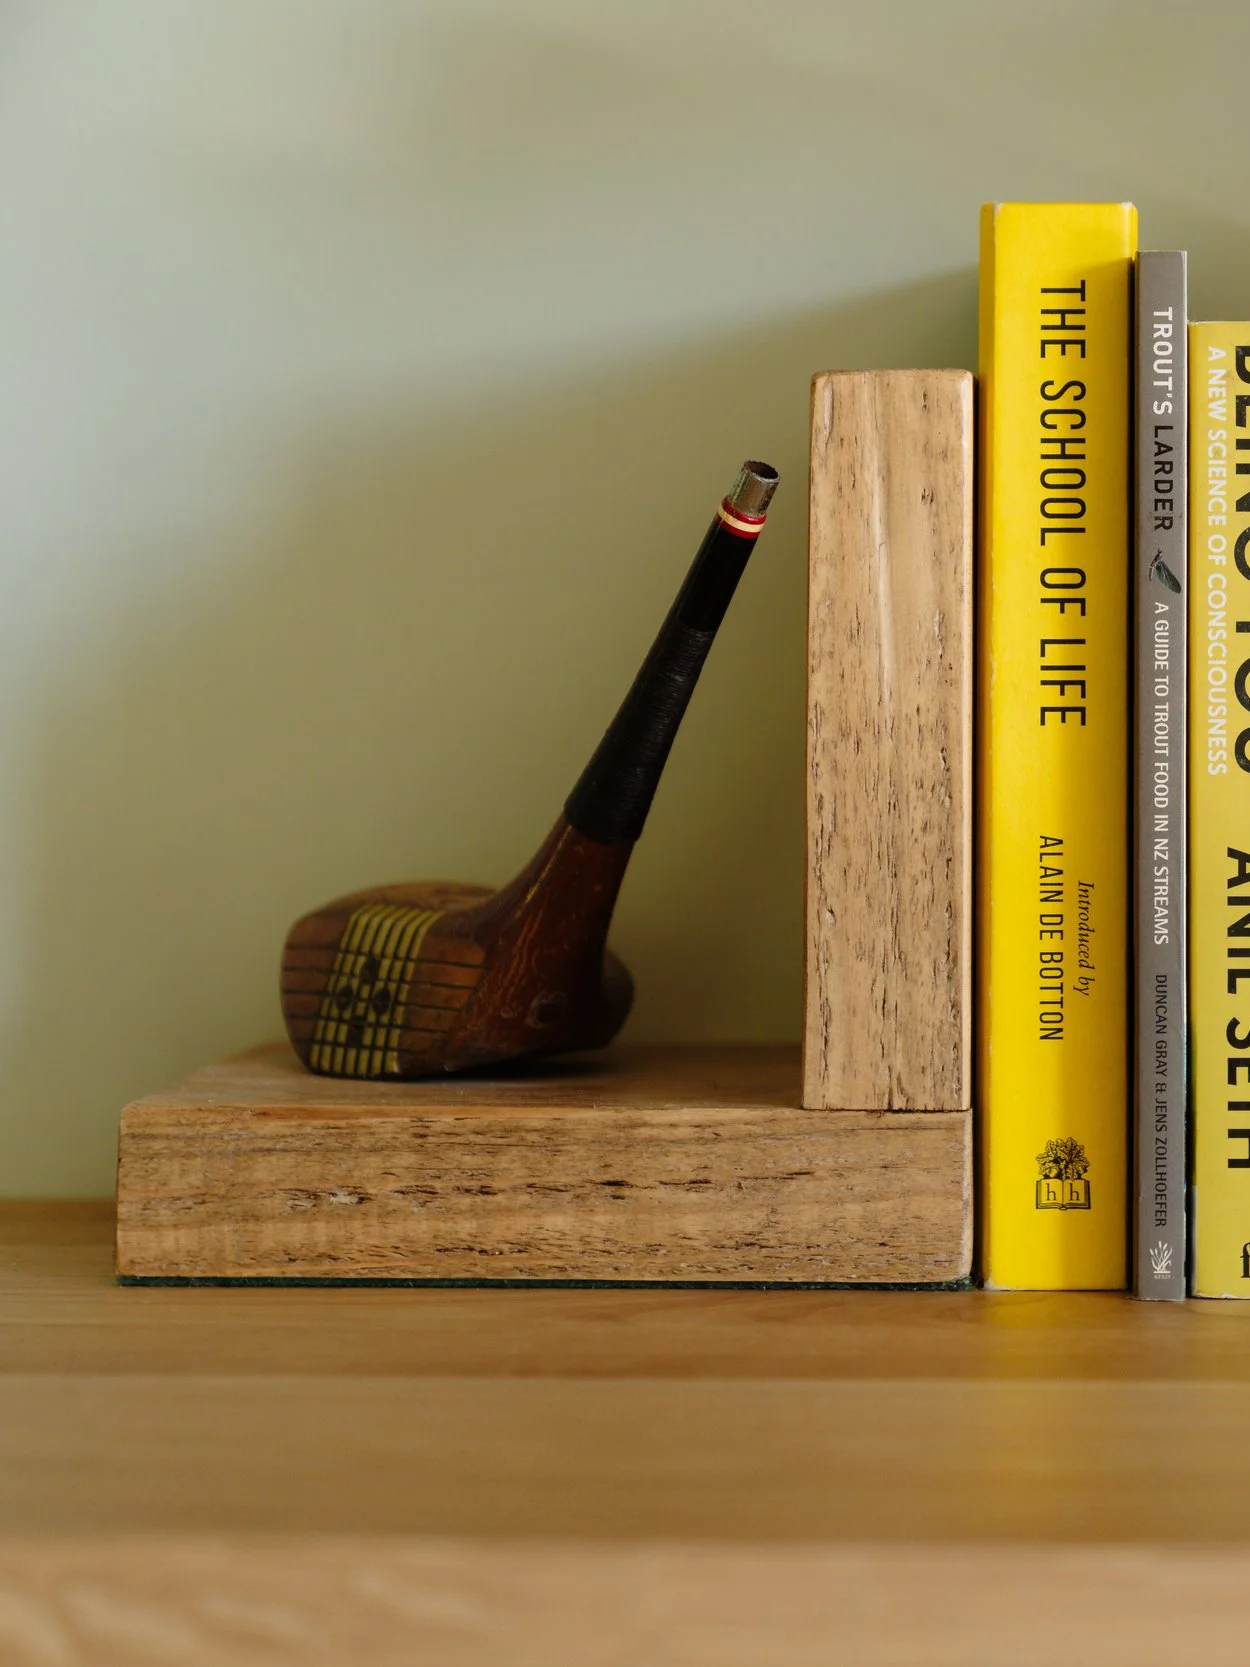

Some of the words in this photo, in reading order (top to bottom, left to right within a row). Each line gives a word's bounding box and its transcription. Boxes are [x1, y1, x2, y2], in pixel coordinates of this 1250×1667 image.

[1040, 280, 1086, 359] THE
[1153, 307, 1173, 416] TROUT'S
[1208, 347, 1227, 360] A
[1208, 370, 1227, 421] NEW
[1040, 380, 1086, 546] SCHOOL
[1154, 425, 1174, 532] LARDER
[1208, 429, 1227, 526] SCIENCE
[1208, 534, 1227, 566] OF
[1040, 568, 1086, 617] OF
[1154, 602, 1169, 614] A
[1153, 620, 1169, 670] GUIDE
[1040, 639, 1086, 727] LIFE
[1153, 676, 1169, 697] TO
[1208, 573, 1228, 775] CONSCIOUSNESS
[1153, 703, 1169, 755] TROUT
[1153, 762, 1169, 808] FOOD
[1153, 815, 1169, 831] IN
[1039, 835, 1064, 903] ALAIN
[1154, 839, 1169, 860] NZ
[1039, 913, 1064, 941] DE
[1078, 881, 1096, 970] Introduced
[1153, 866, 1169, 944] STREAMS
[1039, 951, 1064, 1041] BOTTON
[1073, 976, 1095, 996] by
[1155, 974, 1168, 1034] DUNCAN
[1155, 1040, 1168, 1077] GRAY
[1154, 1098, 1168, 1132] JENS
[1154, 1137, 1168, 1227] ZOLLHOEFER
